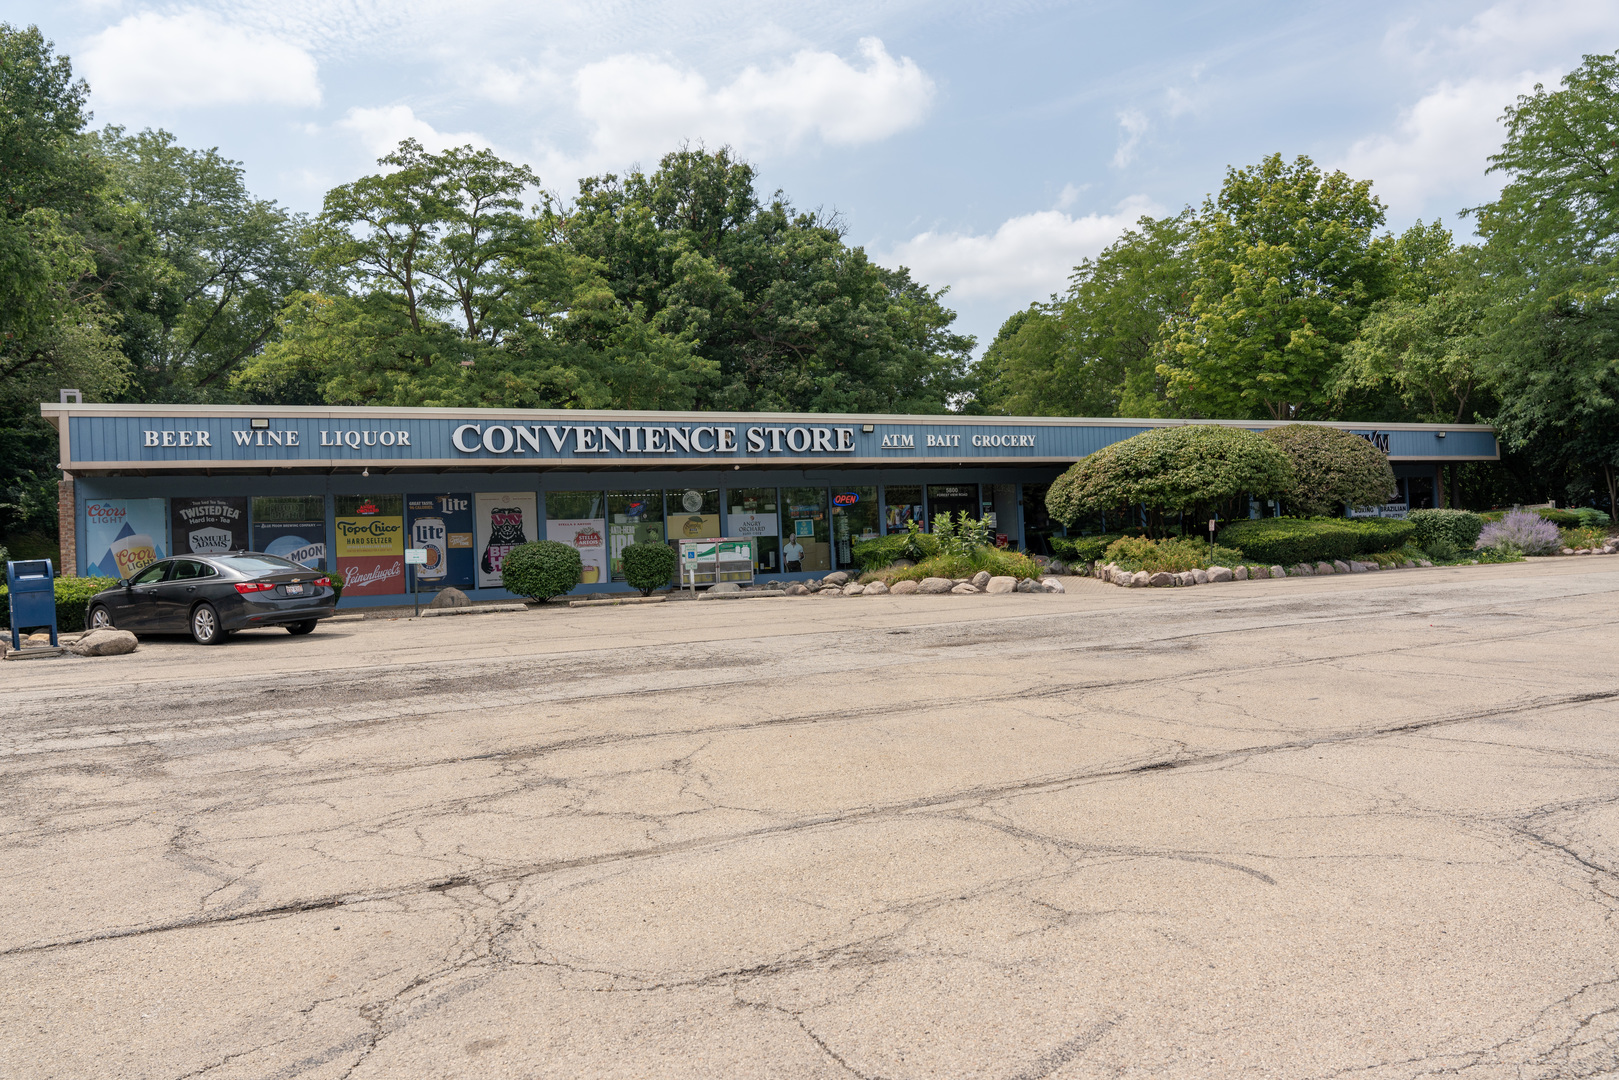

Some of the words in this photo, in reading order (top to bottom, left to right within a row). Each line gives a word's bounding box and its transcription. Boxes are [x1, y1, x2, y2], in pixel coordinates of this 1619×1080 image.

[143, 430, 212, 447] BEER
[231, 430, 300, 447] WINE
[319, 430, 412, 450] LIQUOR
[452, 423, 738, 454] CONVENIENCE
[746, 426, 855, 453] STORE
[881, 434, 915, 447] ATM
[926, 434, 960, 447] BAIT
[971, 434, 1036, 447] GROCERY
[441, 498, 468, 514] Lite
[835, 495, 857, 505] OPEN
[87, 503, 127, 517] Coors
[179, 505, 222, 520] TWISTED
[222, 506, 240, 519] TEA
[92, 516, 123, 524] LIGHT
[337, 521, 371, 537] Topo
[369, 520, 400, 537] Chico
[415, 525, 443, 543] Lite
[191, 535, 231, 544] SAMUEL
[194, 541, 228, 550] ADAMS
[116, 548, 157, 567] Coors
[290, 544, 323, 562] MOON
[342, 561, 401, 590] Leinenkugel's
